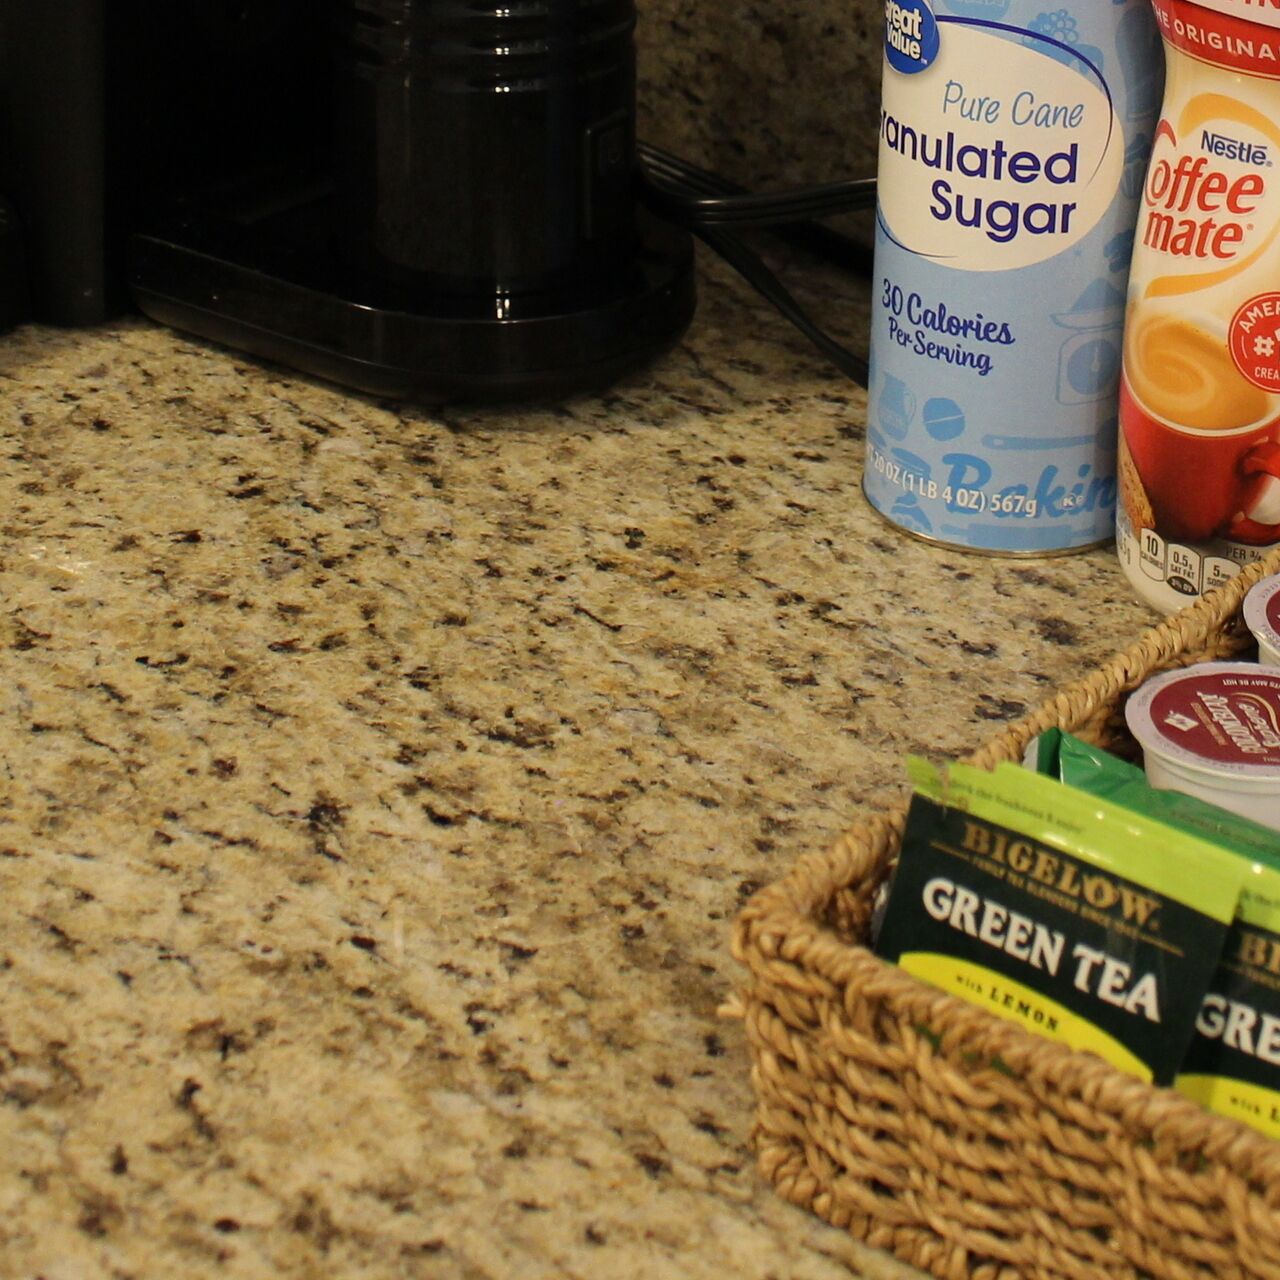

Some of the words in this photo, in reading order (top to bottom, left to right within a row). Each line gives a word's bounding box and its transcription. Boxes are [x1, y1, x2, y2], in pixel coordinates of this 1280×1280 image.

[886, 20, 920, 59] Value
[943, 80, 999, 124] Pure
[1012, 91, 1085, 128] Cane
[881, 107, 1078, 184] ranulated
[1201, 129, 1268, 166] Nestlé
[929, 179, 1076, 243] Sugar
[1143, 211, 1244, 259] mate
[882, 278, 903, 316] 30
[906, 291, 1016, 346] Calories
[888, 316, 912, 349] Per
[913, 330, 994, 376] Serving
[885, 459, 900, 485] OZ
[919, 478, 937, 499] LB
[942, 489, 953, 504] 4
[956, 490, 985, 512] OZ)
[990, 495, 1037, 518] 567g
[1146, 535, 1158, 557] 10
[1183, 568, 1195, 579] FAT
[1226, 547, 1246, 560] PER
[962, 822, 1163, 927] BIGELOW
[922, 876, 1066, 978] GREEN
[1072, 943, 1161, 1024] TEA
[955, 973, 984, 996] with
[988, 985, 1060, 1034] LEMON
